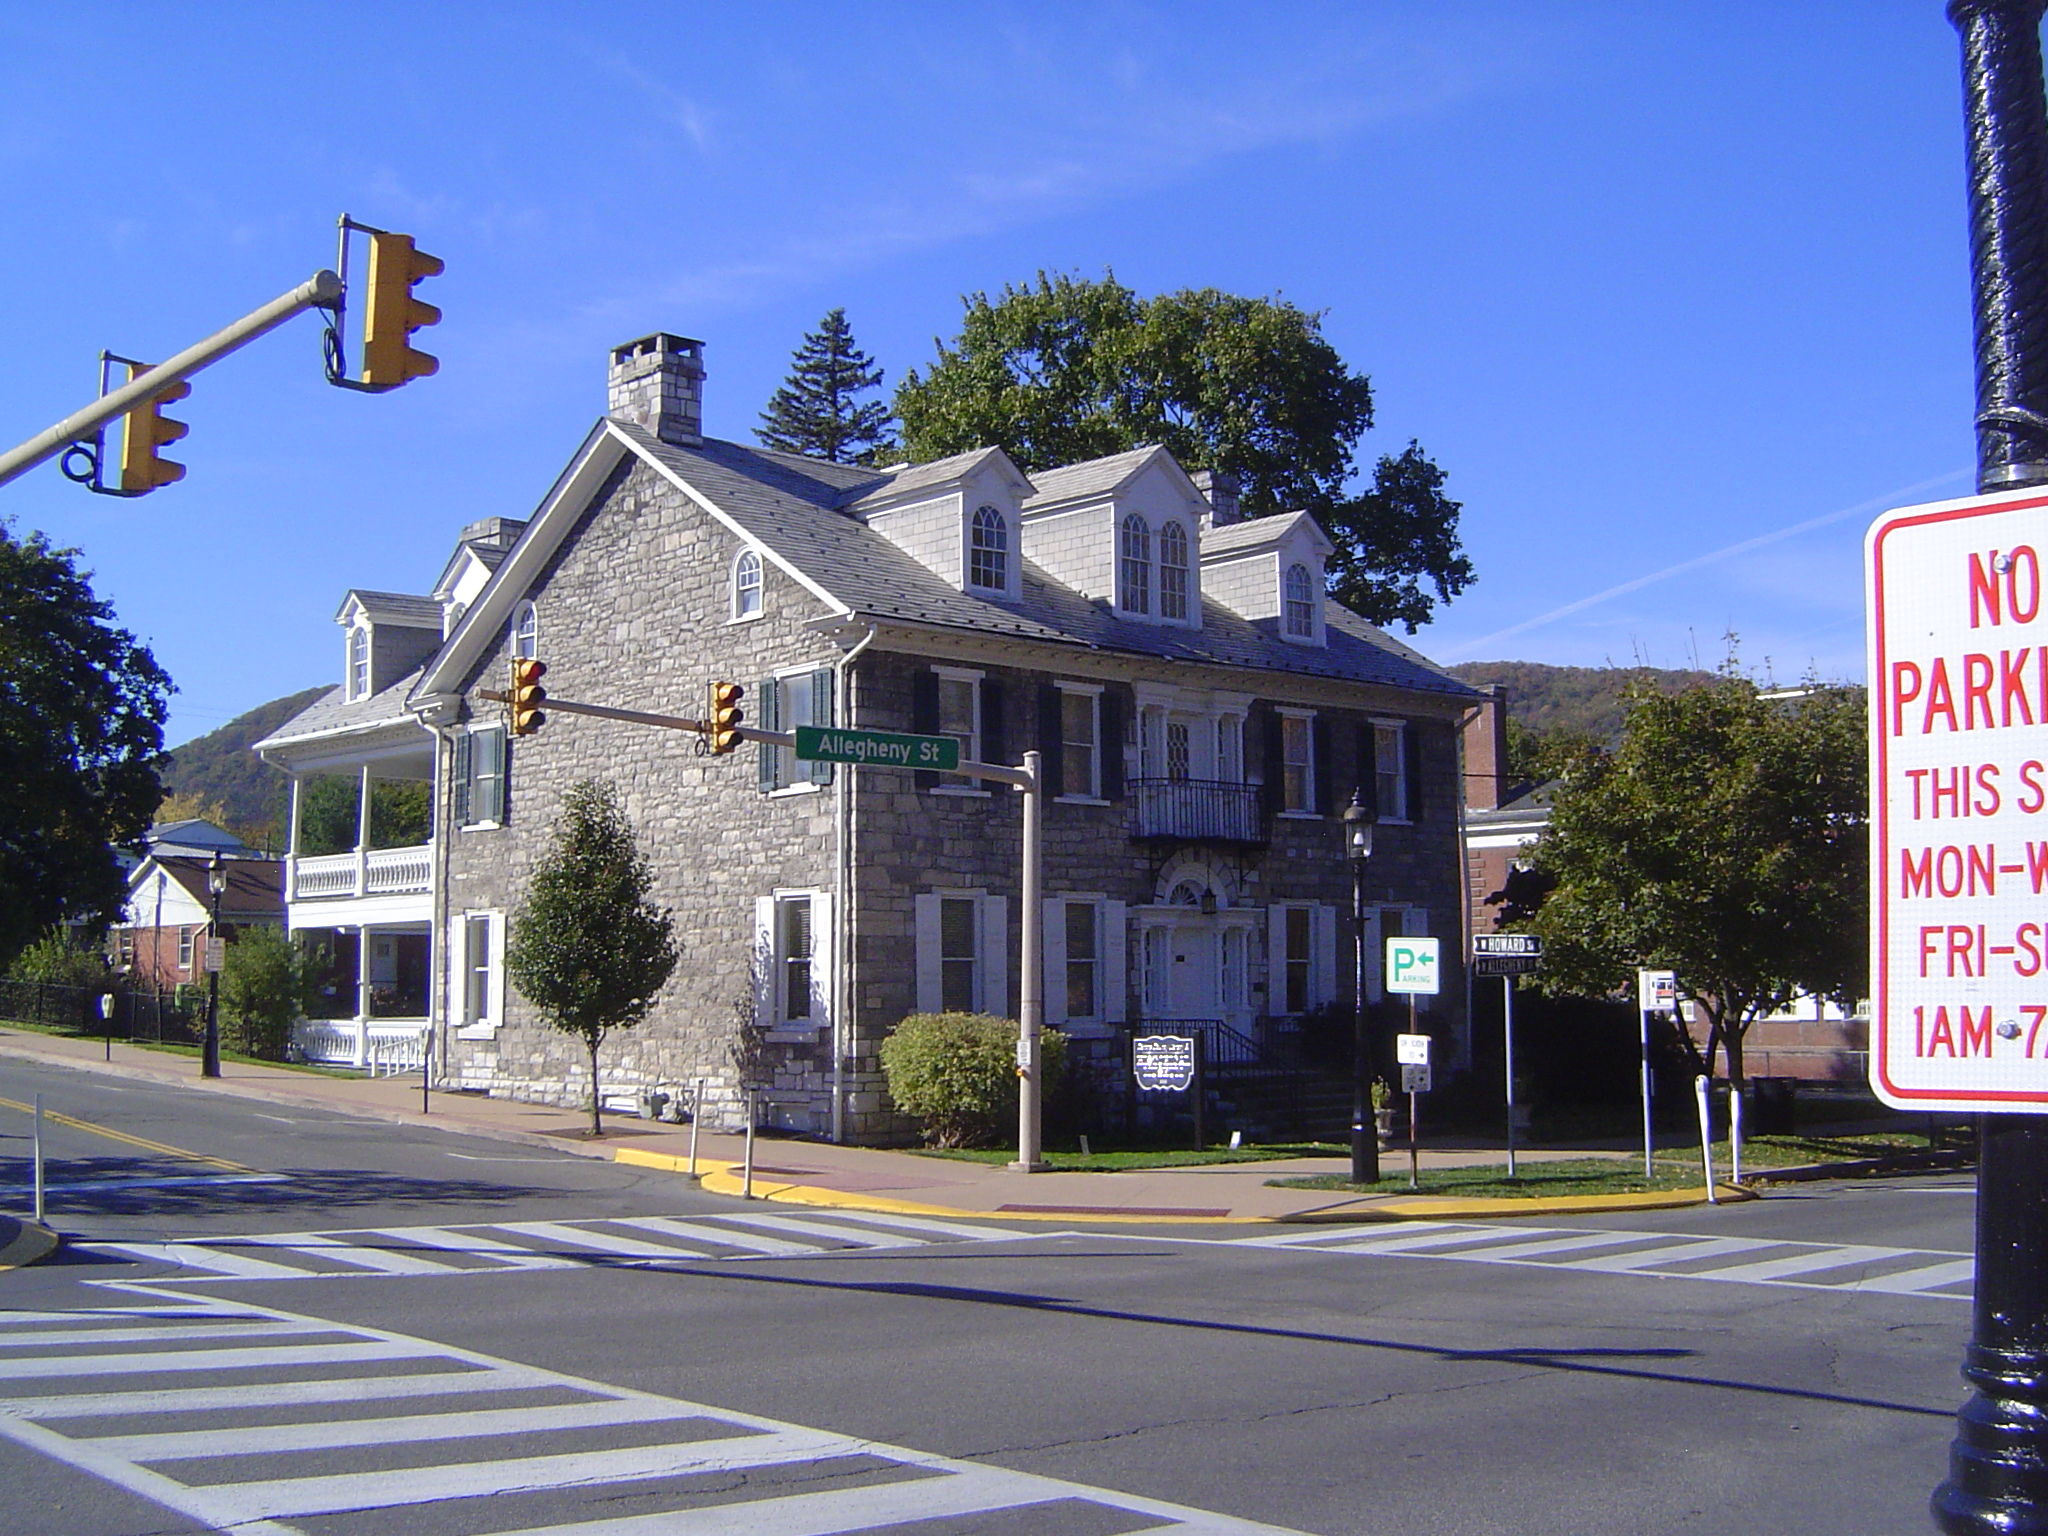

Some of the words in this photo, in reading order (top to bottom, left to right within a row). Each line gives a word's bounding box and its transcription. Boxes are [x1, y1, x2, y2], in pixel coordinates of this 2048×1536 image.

[1968, 545, 2040, 629] NO
[1892, 645, 2048, 737] PARKI
[818, 734, 911, 763] Allegheny
[919, 742, 940, 761] St
[1904, 763, 2000, 820] THIS
[1488, 937, 1526, 952] HOWARD
[1919, 922, 2048, 978] FRI-S
